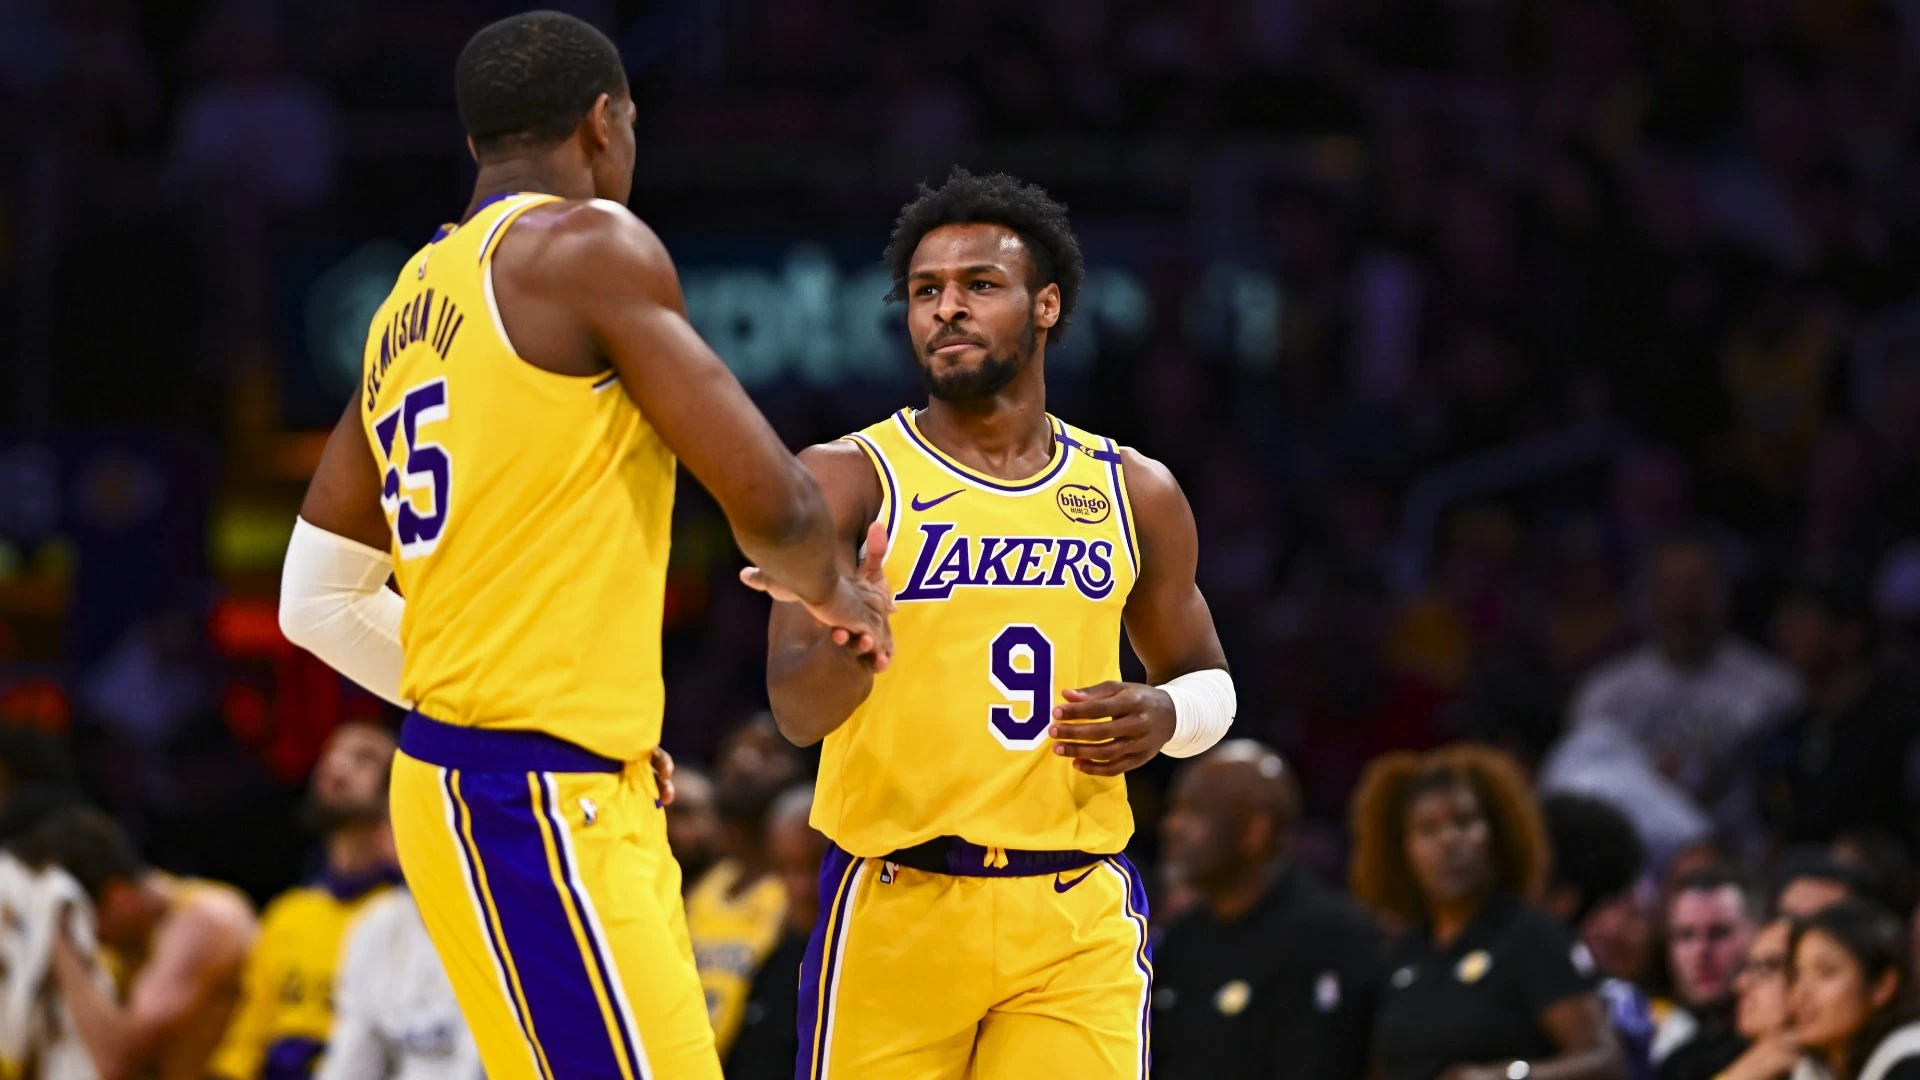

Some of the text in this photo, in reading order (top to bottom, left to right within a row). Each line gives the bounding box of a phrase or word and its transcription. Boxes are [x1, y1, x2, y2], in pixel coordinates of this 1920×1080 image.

[431, 295, 464, 362] III
[1060, 493, 1107, 513] bibigo
[894, 521, 1115, 602] LAKERS
[988, 622, 1055, 750] 9
